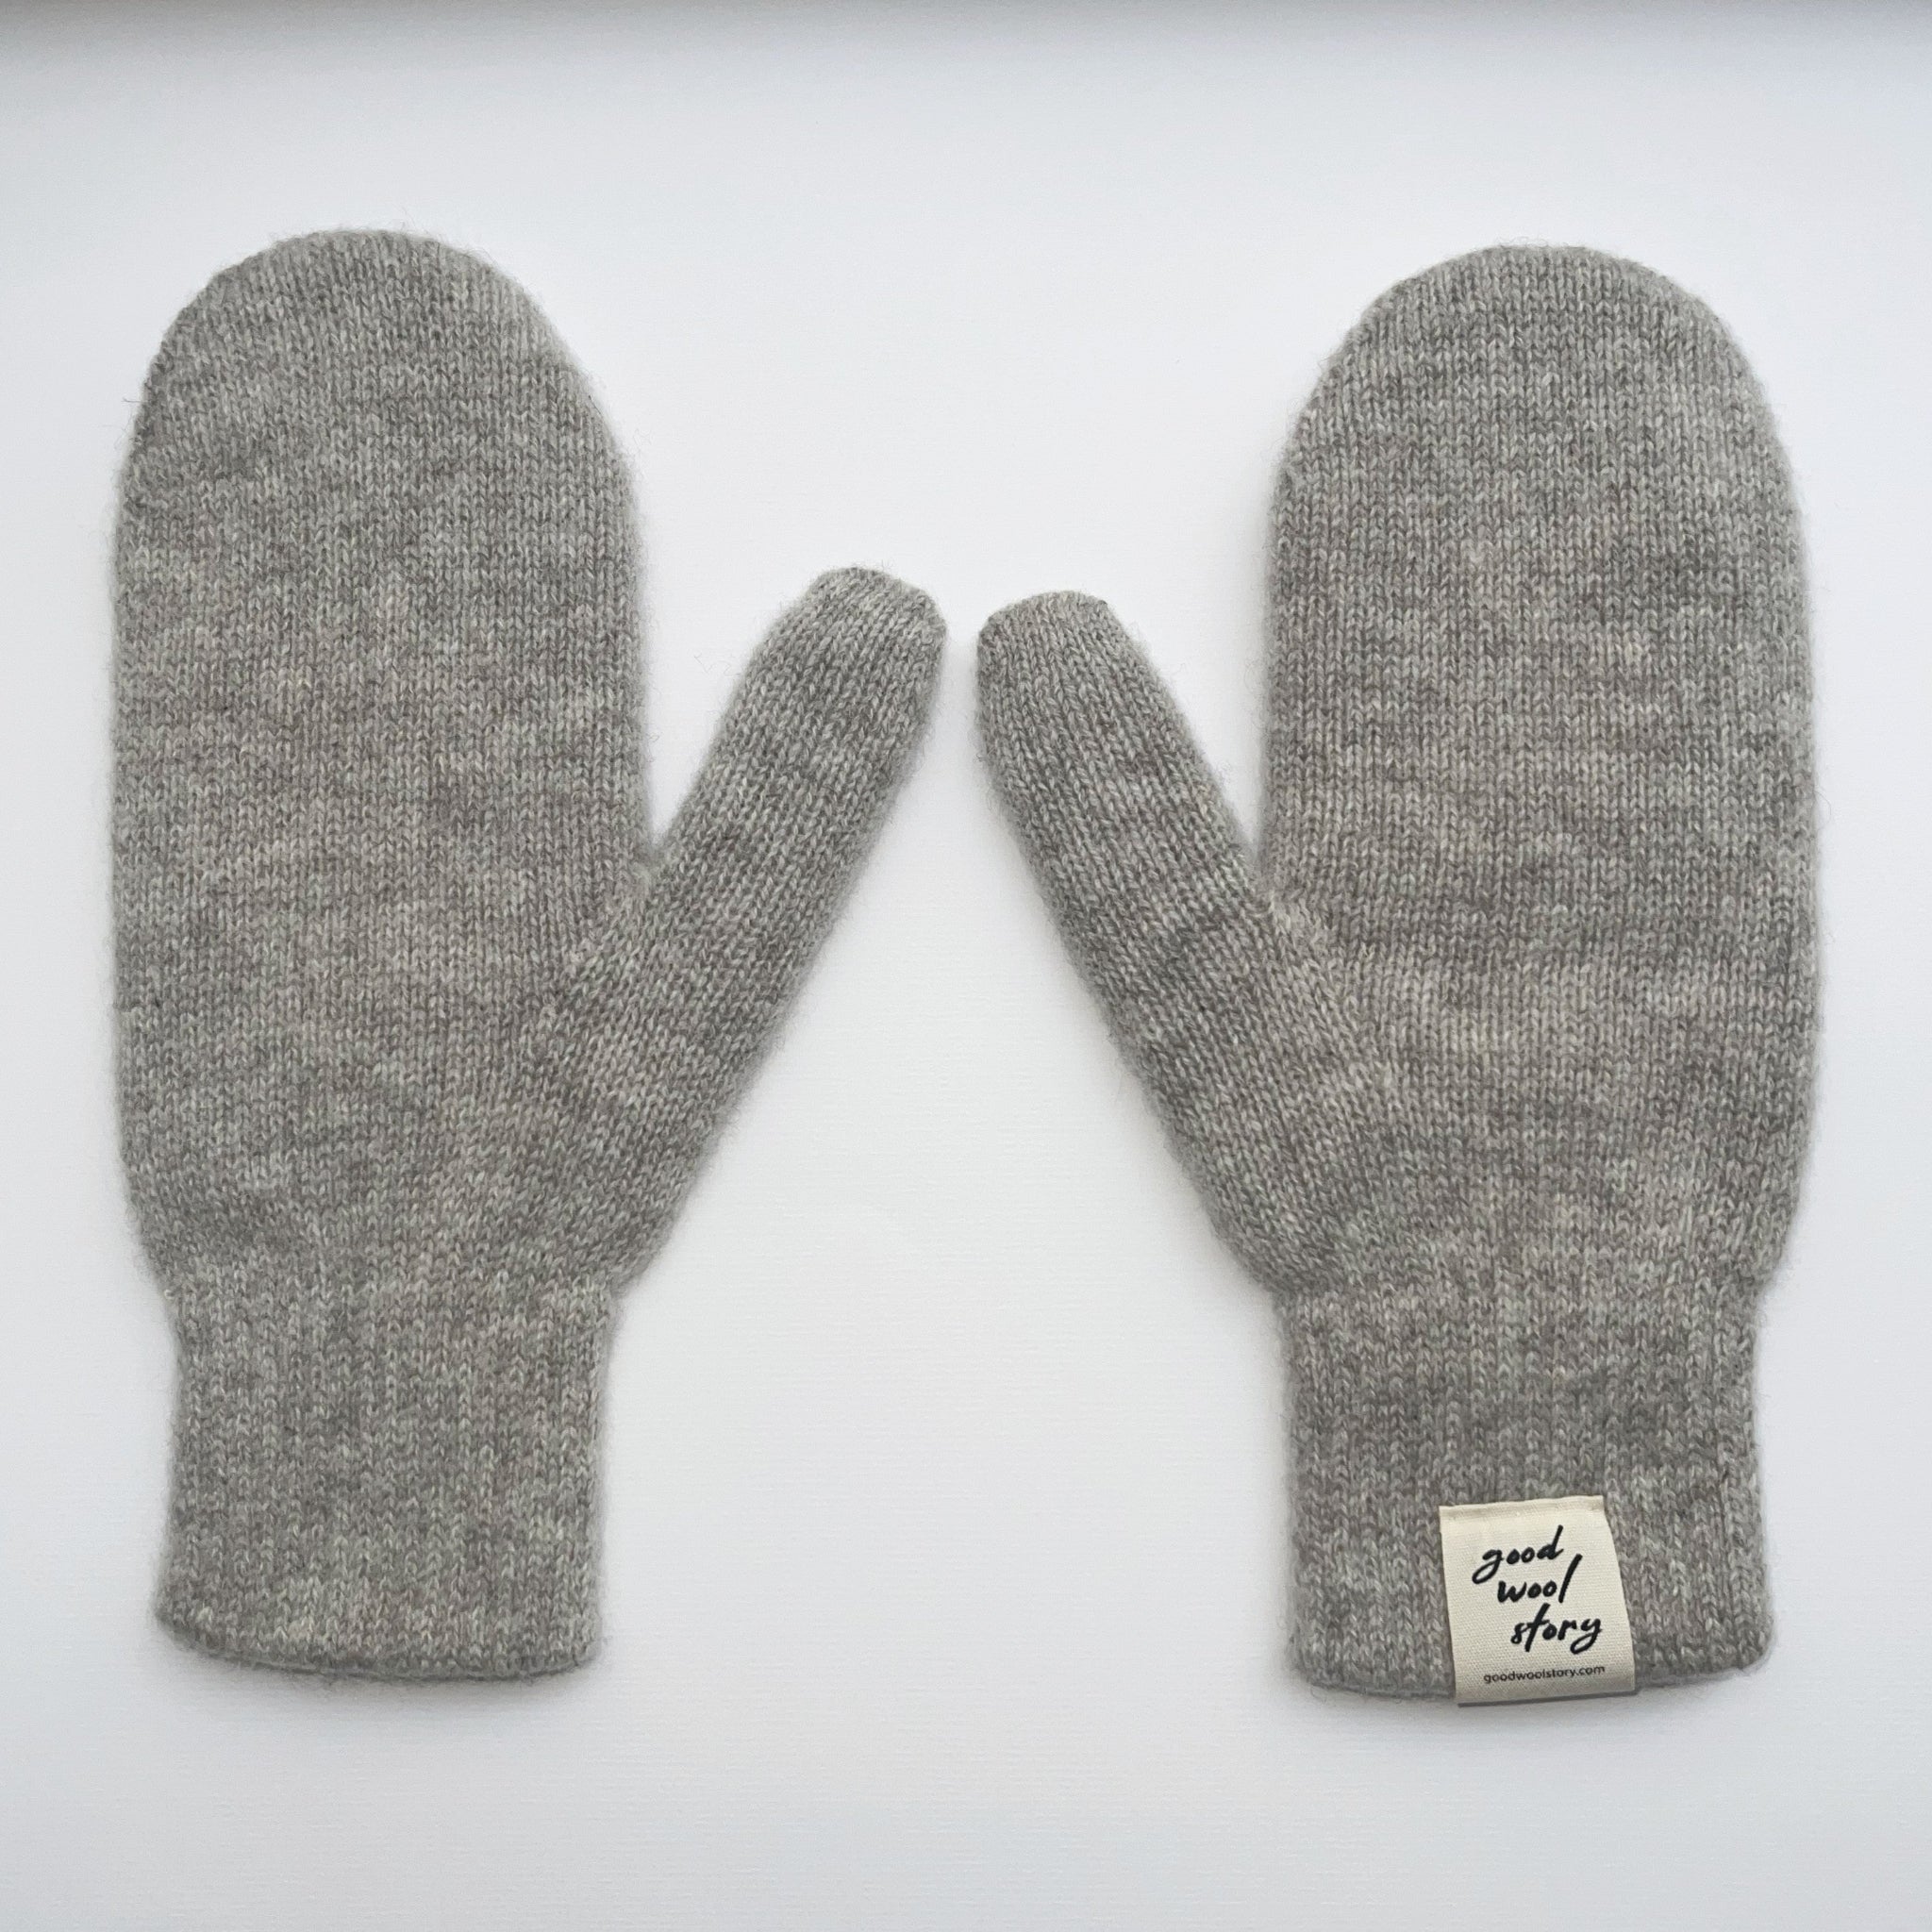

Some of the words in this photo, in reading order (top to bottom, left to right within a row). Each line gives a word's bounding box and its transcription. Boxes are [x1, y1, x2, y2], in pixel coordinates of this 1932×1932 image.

[1472, 1524, 1564, 1585] good
[1497, 1554, 1583, 1604] wool
[1510, 1603, 1602, 1656] story
[1483, 1665, 1606, 1685] goodwoolstory.com
